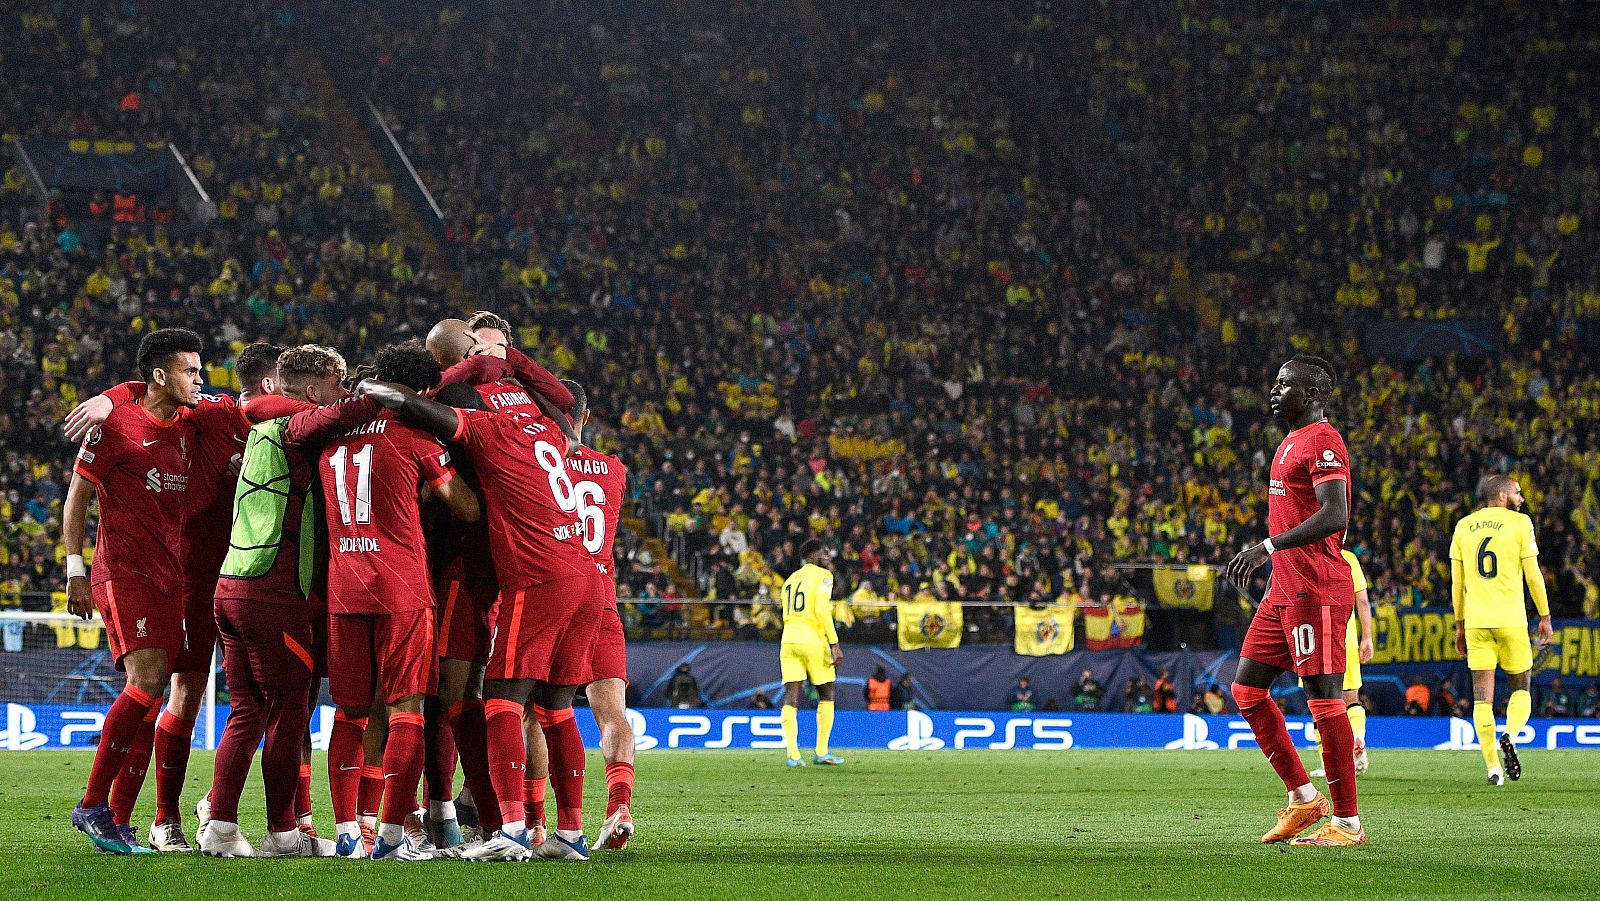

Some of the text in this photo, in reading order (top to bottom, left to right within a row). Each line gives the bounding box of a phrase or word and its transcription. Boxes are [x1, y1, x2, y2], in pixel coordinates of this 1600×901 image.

[490, 391, 532, 410] FABINHO
[163, 472, 189, 485] standa
[534, 440, 577, 513] 8
[1316, 459, 1342, 469] Expedia
[329, 443, 374, 525] 11
[573, 480, 606, 555] 6
[1475, 536, 1498, 579] 6
[785, 581, 805, 615] 16
[1291, 623, 1316, 658] 10
[667, 716, 785, 749] PS5
[954, 717, 1075, 750] PS5
